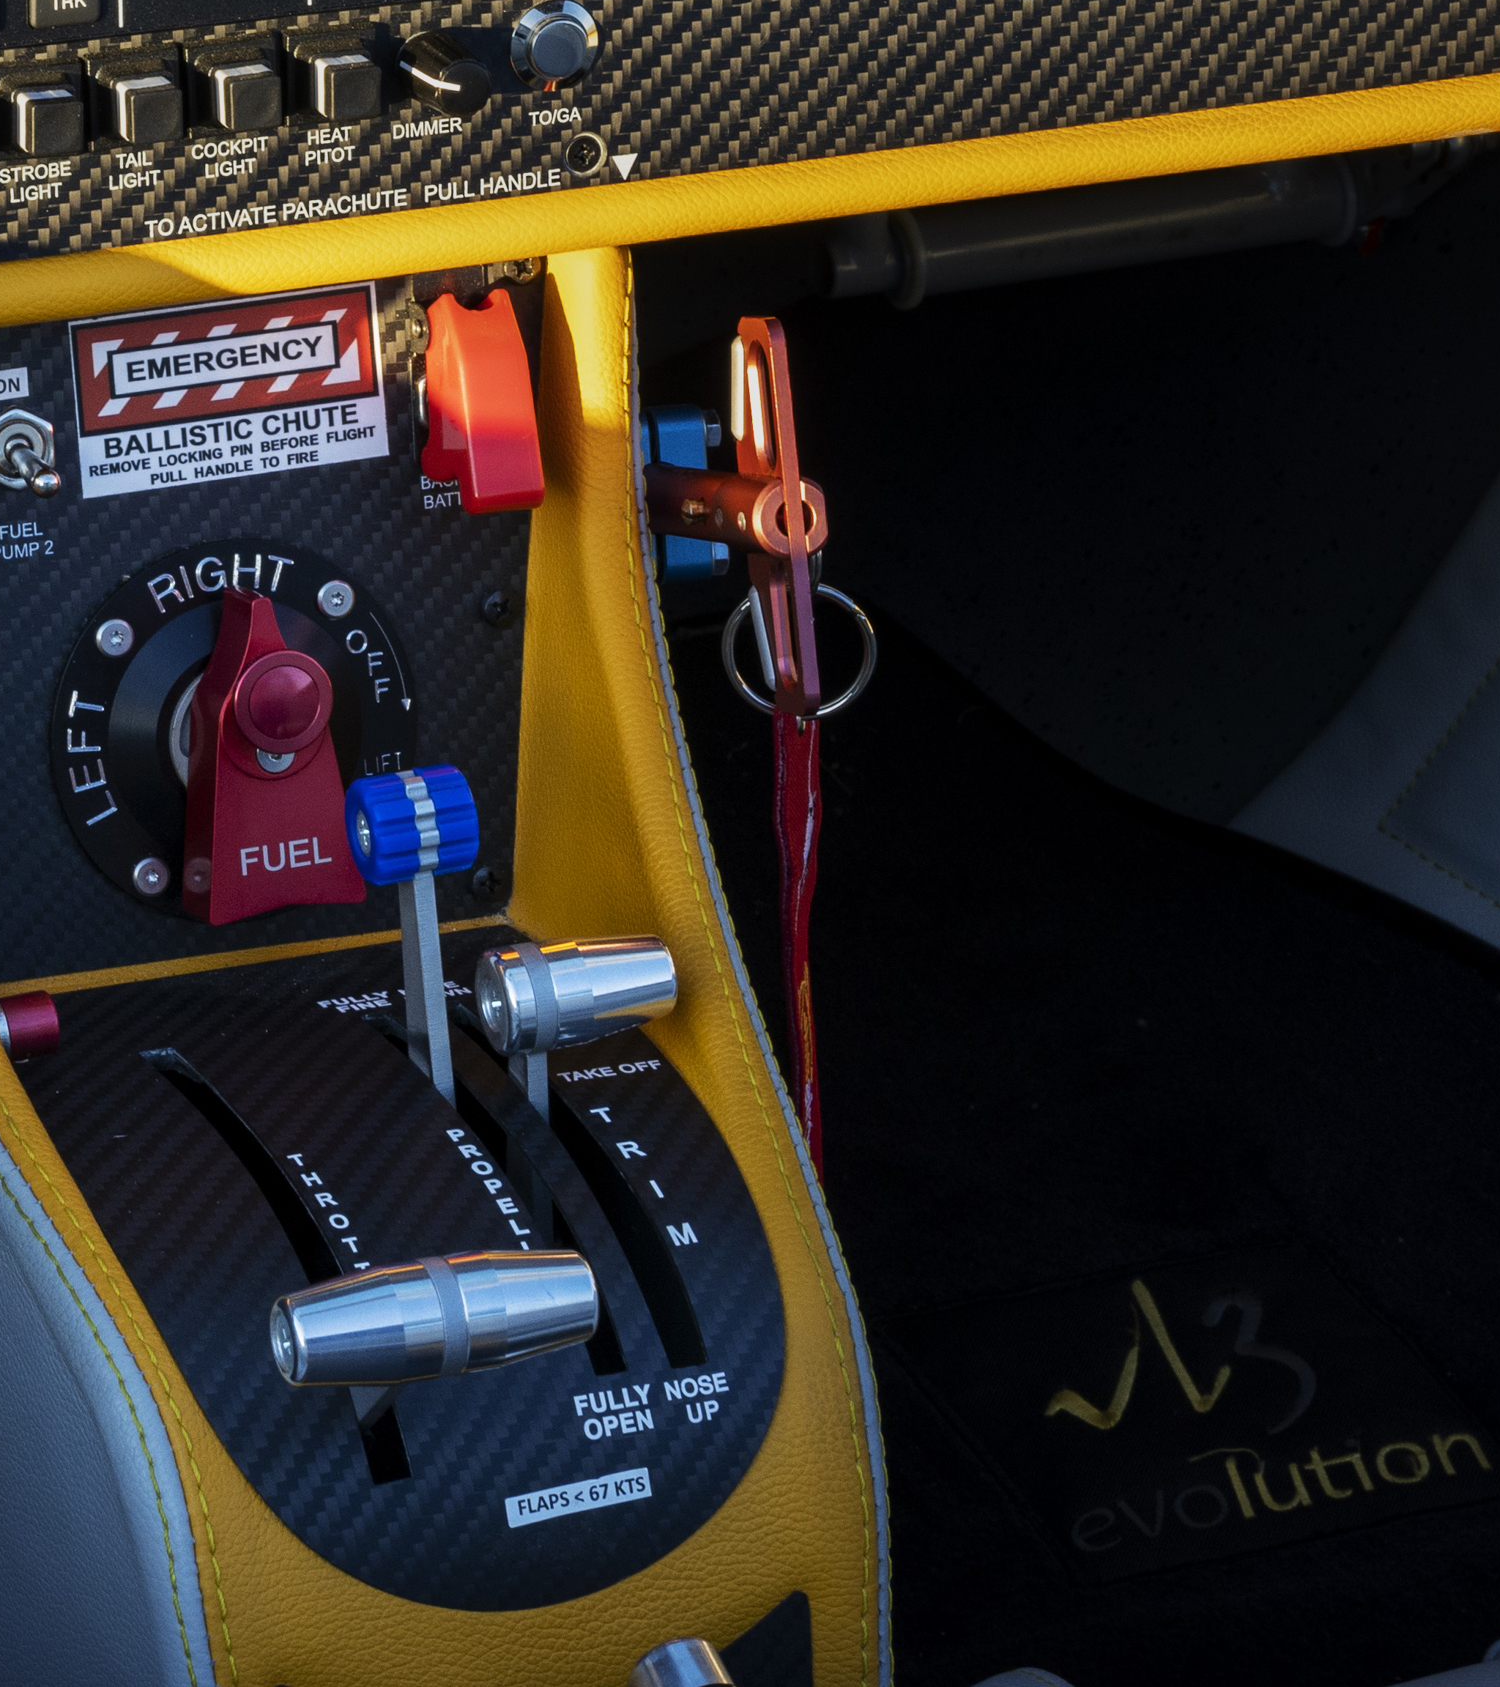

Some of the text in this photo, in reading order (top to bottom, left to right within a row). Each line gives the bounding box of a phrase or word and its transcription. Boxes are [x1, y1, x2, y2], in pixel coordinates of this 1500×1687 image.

[391, 116, 463, 140] DIMMER
[528, 106, 582, 126] TO/GA
[191, 136, 270, 161] COCKPIT
[303, 143, 356, 165] PITOT
[306, 126, 353, 148] HEAT
[204, 156, 258, 179] LIGHT
[143, 167, 562, 238] TO ACTIVATE PARACHUTE PULL HANDLE
[125, 335, 324, 385] EMERGENCY
[102, 402, 359, 459] BALLISTIC CHUTE
[88, 425, 376, 477] REMOVE LOCKING PIN BEFORE FLIGHT
[150, 449, 319, 486] PULL HANDLE TO FIRE
[146, 552, 294, 614] RIGHT
[65, 689, 119, 826] LEFT
[238, 836, 333, 876] FUEL
[558, 1067, 616, 1084] TAKE
[573, 1371, 731, 1418] FULLY NOSE
[685, 1399, 721, 1425] UP
[516, 1474, 647, 1518] FLAPS 67 KTS
